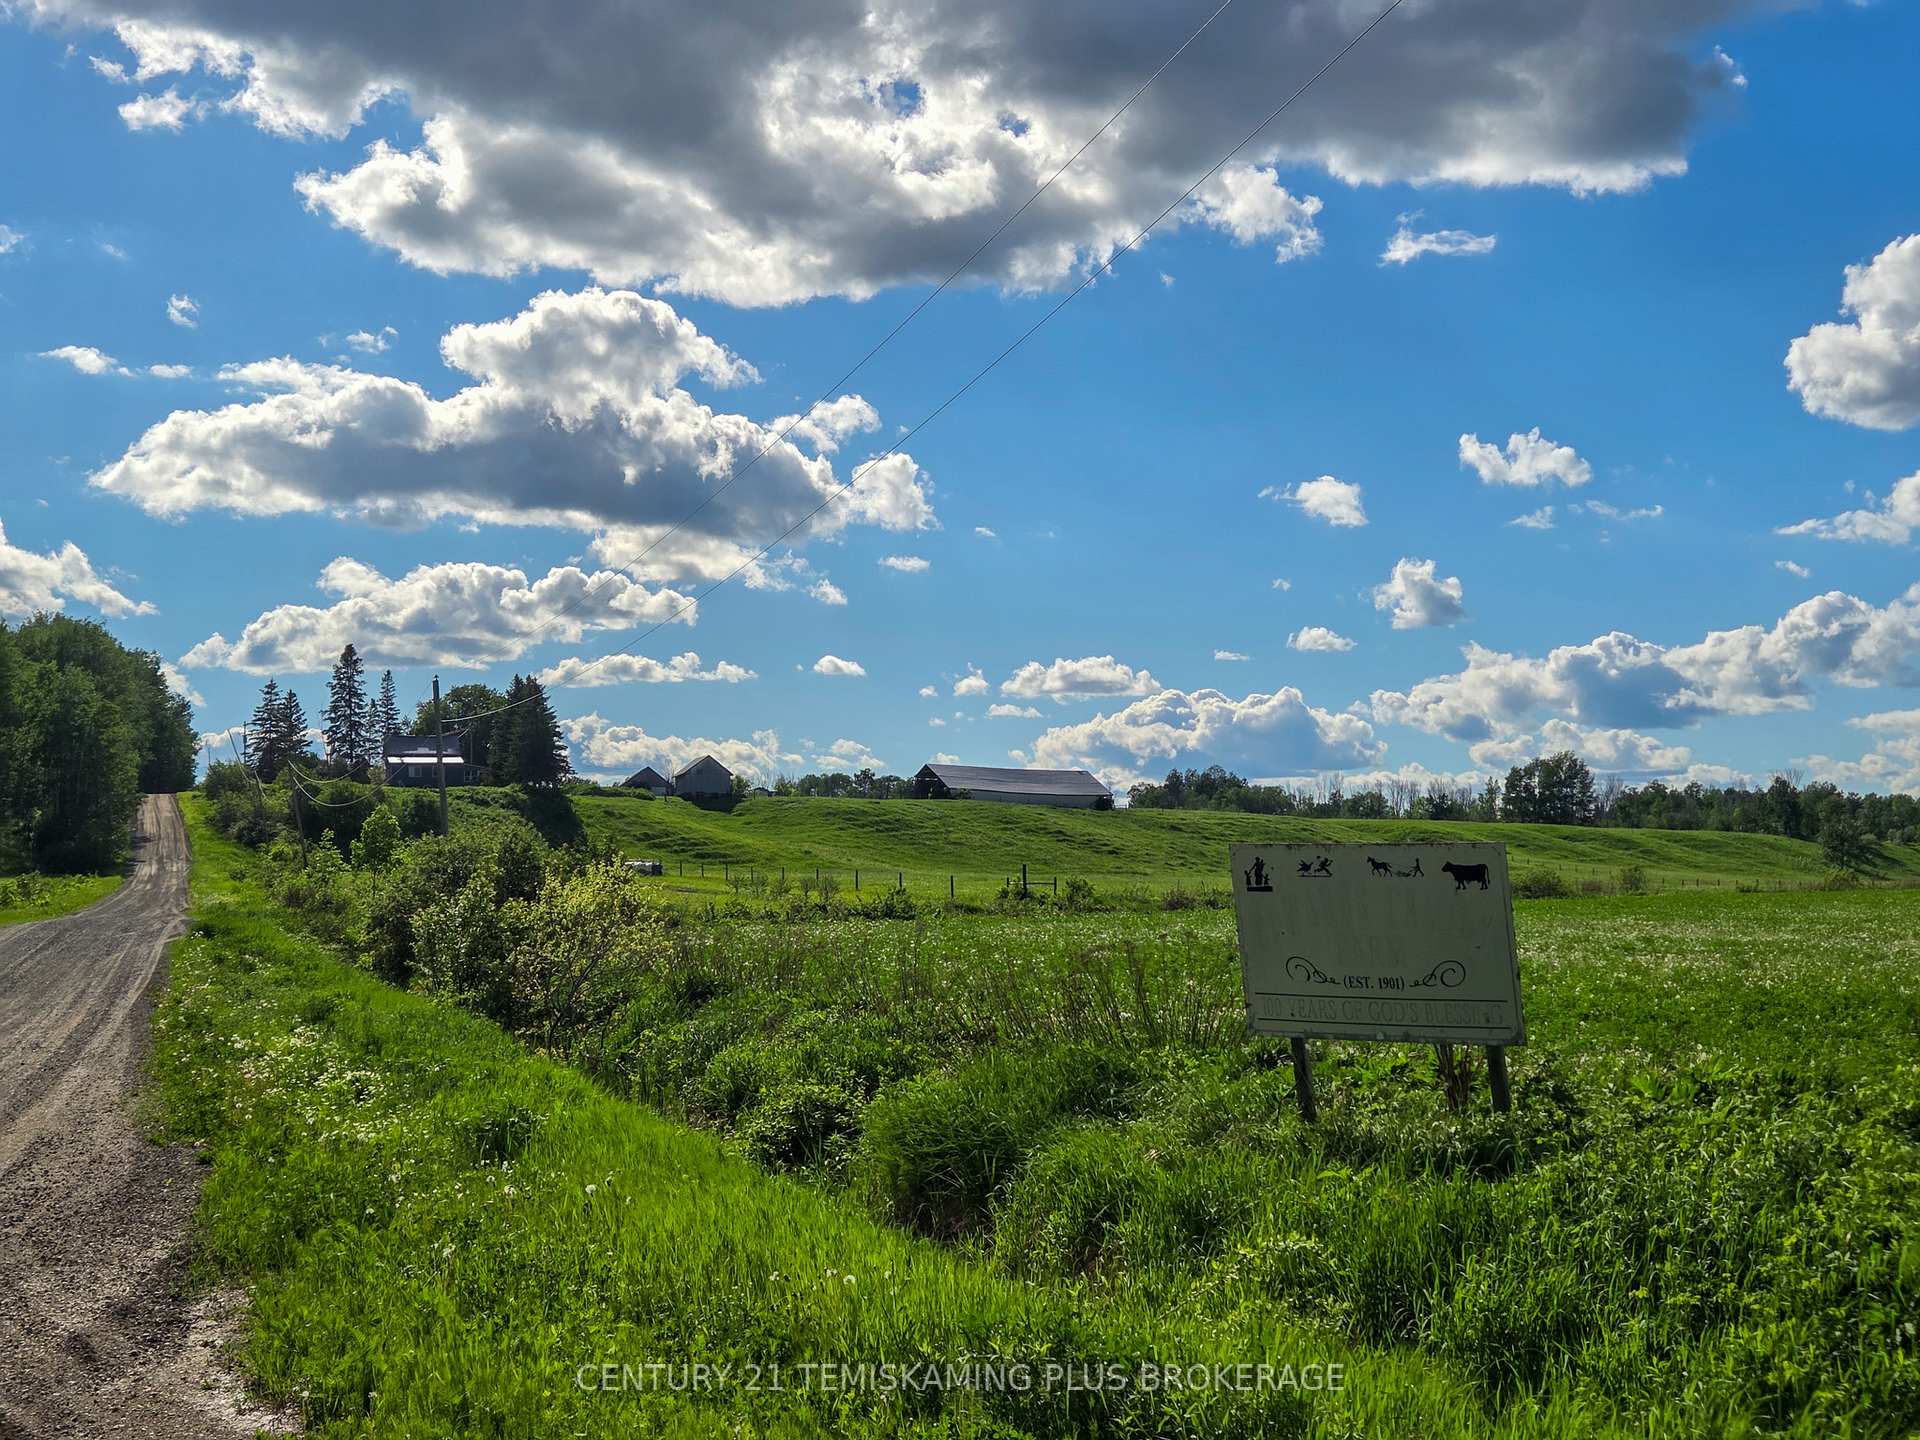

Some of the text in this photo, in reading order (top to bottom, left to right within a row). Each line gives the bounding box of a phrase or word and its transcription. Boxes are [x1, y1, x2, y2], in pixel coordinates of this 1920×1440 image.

[1343, 975, 1405, 992] (EST. 1901)
[1288, 998, 1337, 1020] YEARS
[1367, 1001, 1419, 1023] GOD'S
